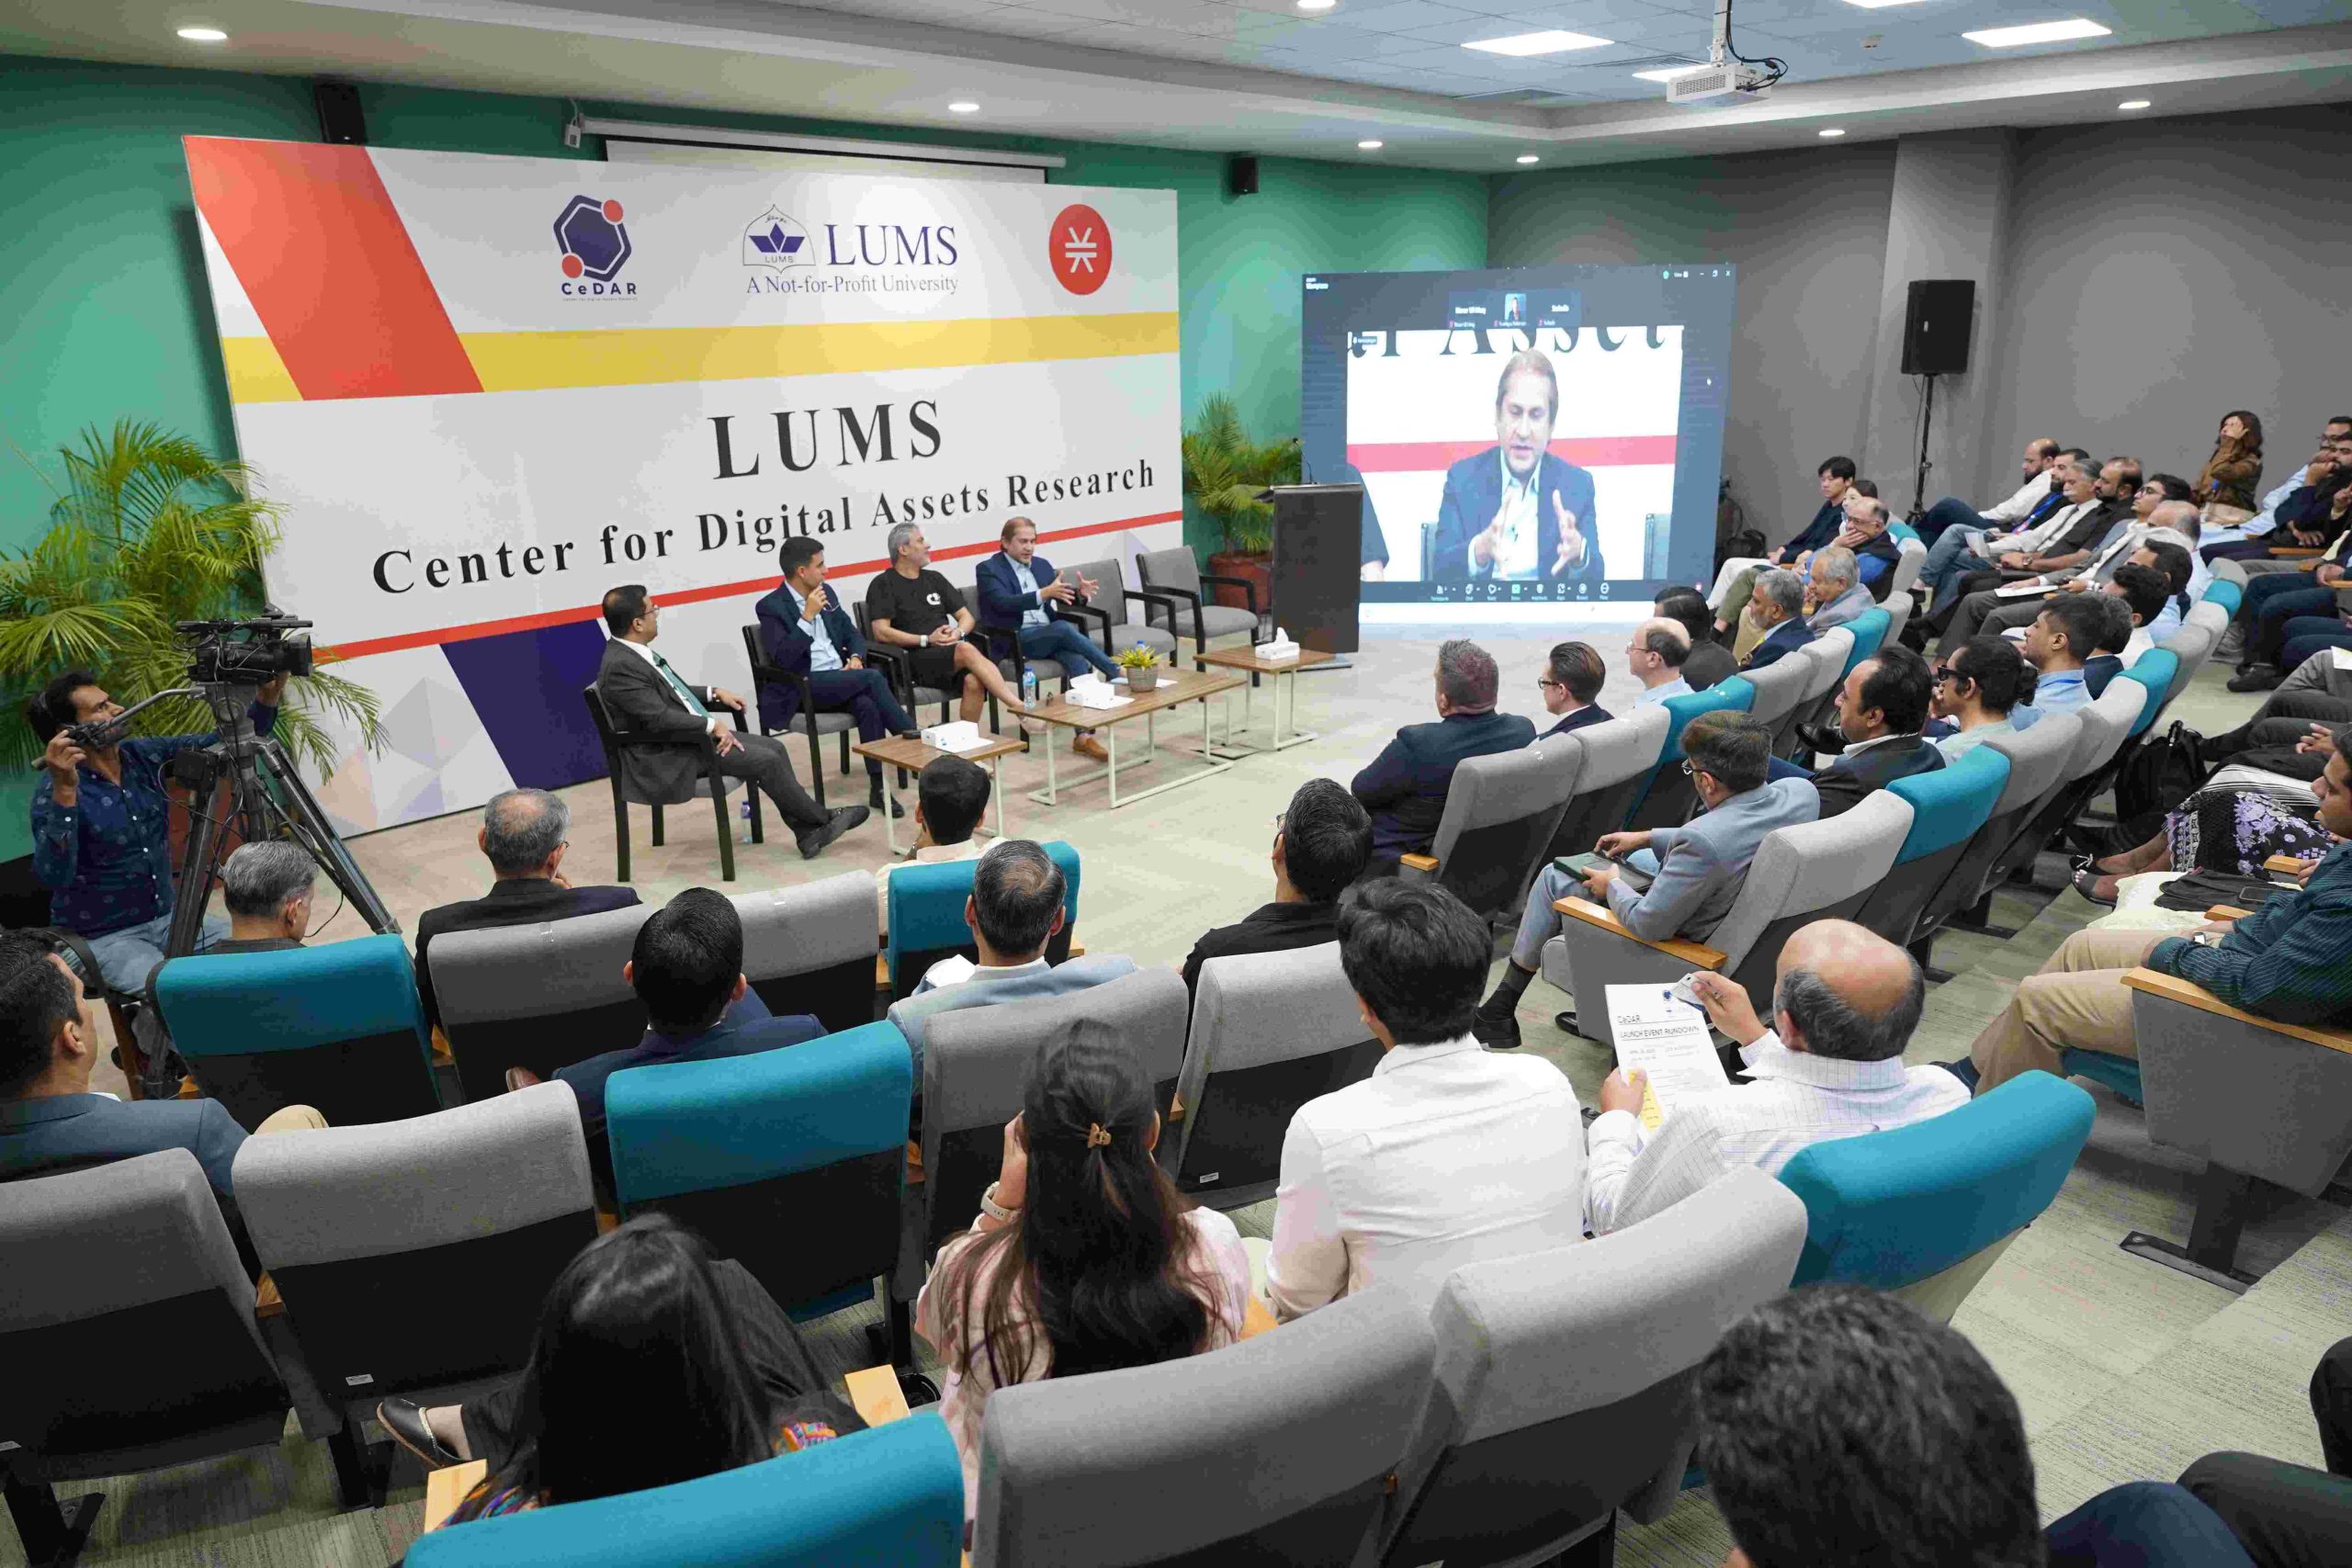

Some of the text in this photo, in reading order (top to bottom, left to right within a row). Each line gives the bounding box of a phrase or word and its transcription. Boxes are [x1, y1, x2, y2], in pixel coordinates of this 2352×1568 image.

[824, 224, 957, 265] LUMS
[764, 255, 794, 264] LUMS
[561, 282, 637, 295] CeDAR
[746, 275, 958, 295] A Not-for-Profit University
[707, 400, 940, 479] LUMS
[373, 459, 1155, 593] Center for Digital Assets Research
[1617, 1014, 1640, 1024] CeDAR
[1621, 1025, 1700, 1039] LAUNCH EVENT RUNDOWN
